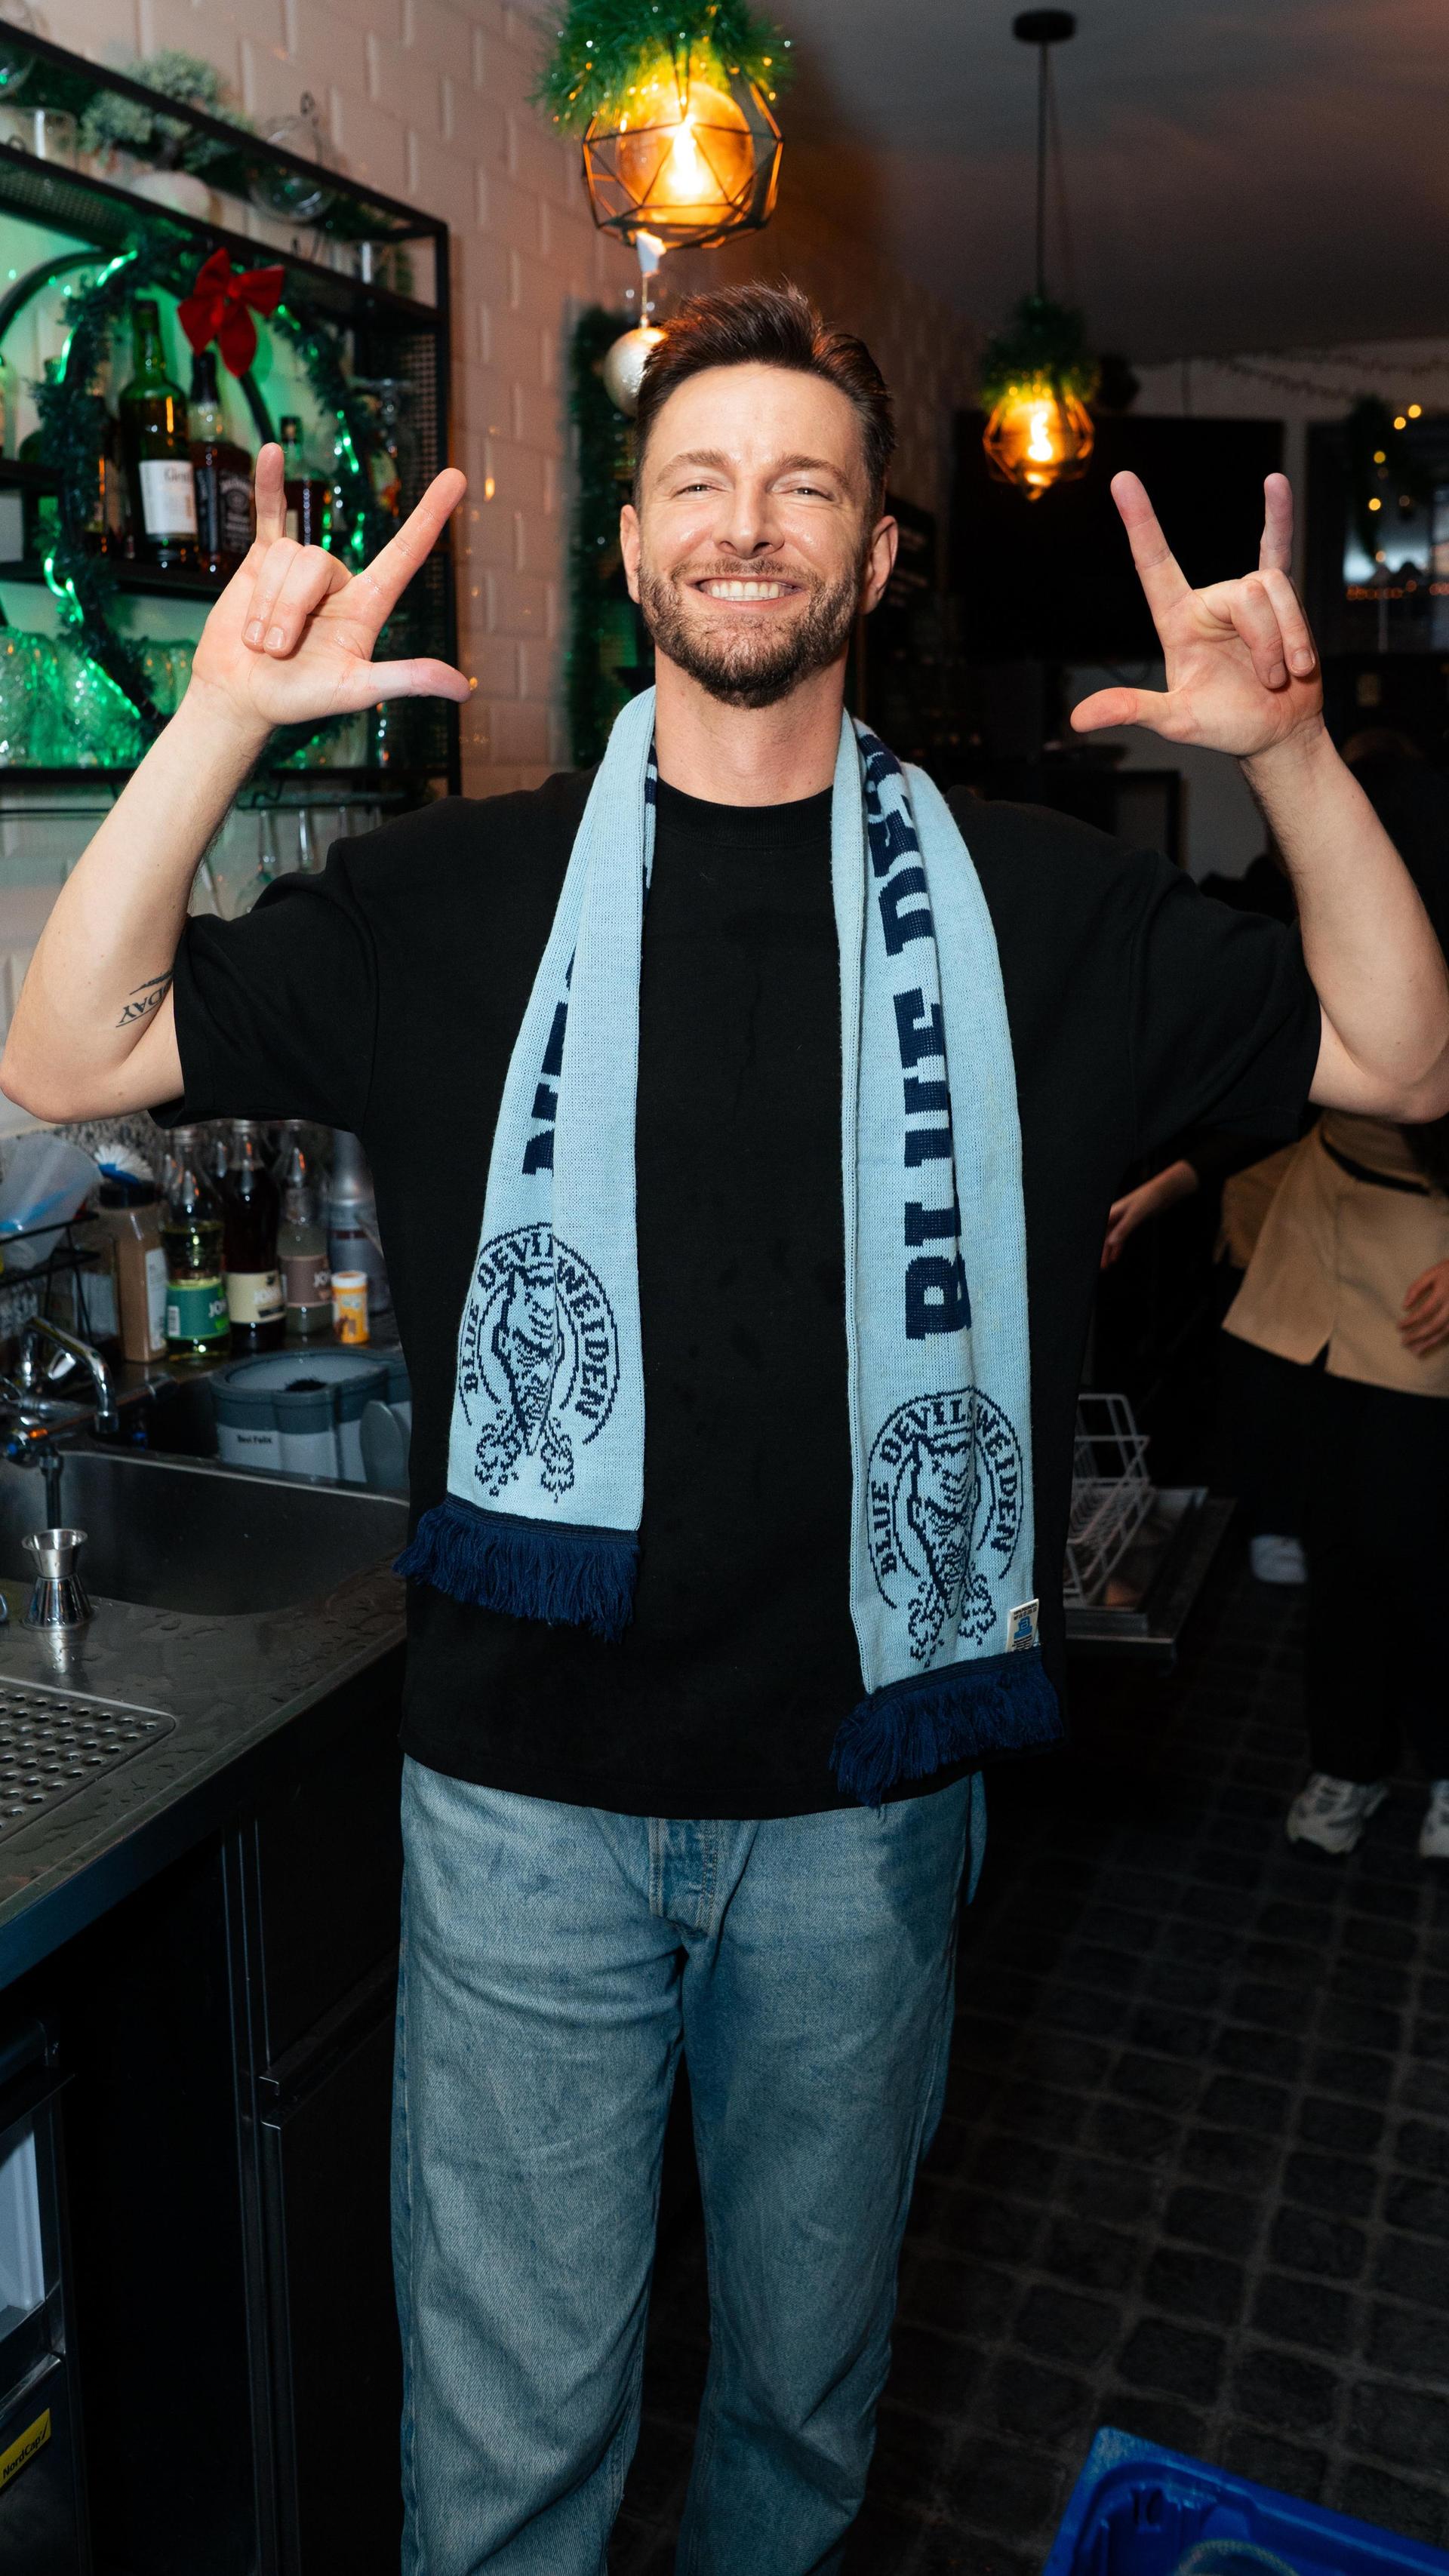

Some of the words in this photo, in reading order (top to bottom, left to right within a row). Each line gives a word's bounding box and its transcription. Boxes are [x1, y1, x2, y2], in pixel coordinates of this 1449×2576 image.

[461, 1302, 480, 1394] BLUE
[556, 1255, 610, 1419] WEIDEN
[870, 1480, 897, 1577] BLUE
[976, 1402, 1018, 1553] WEIDEN
[2, 2436, 42, 2479] NordCap
